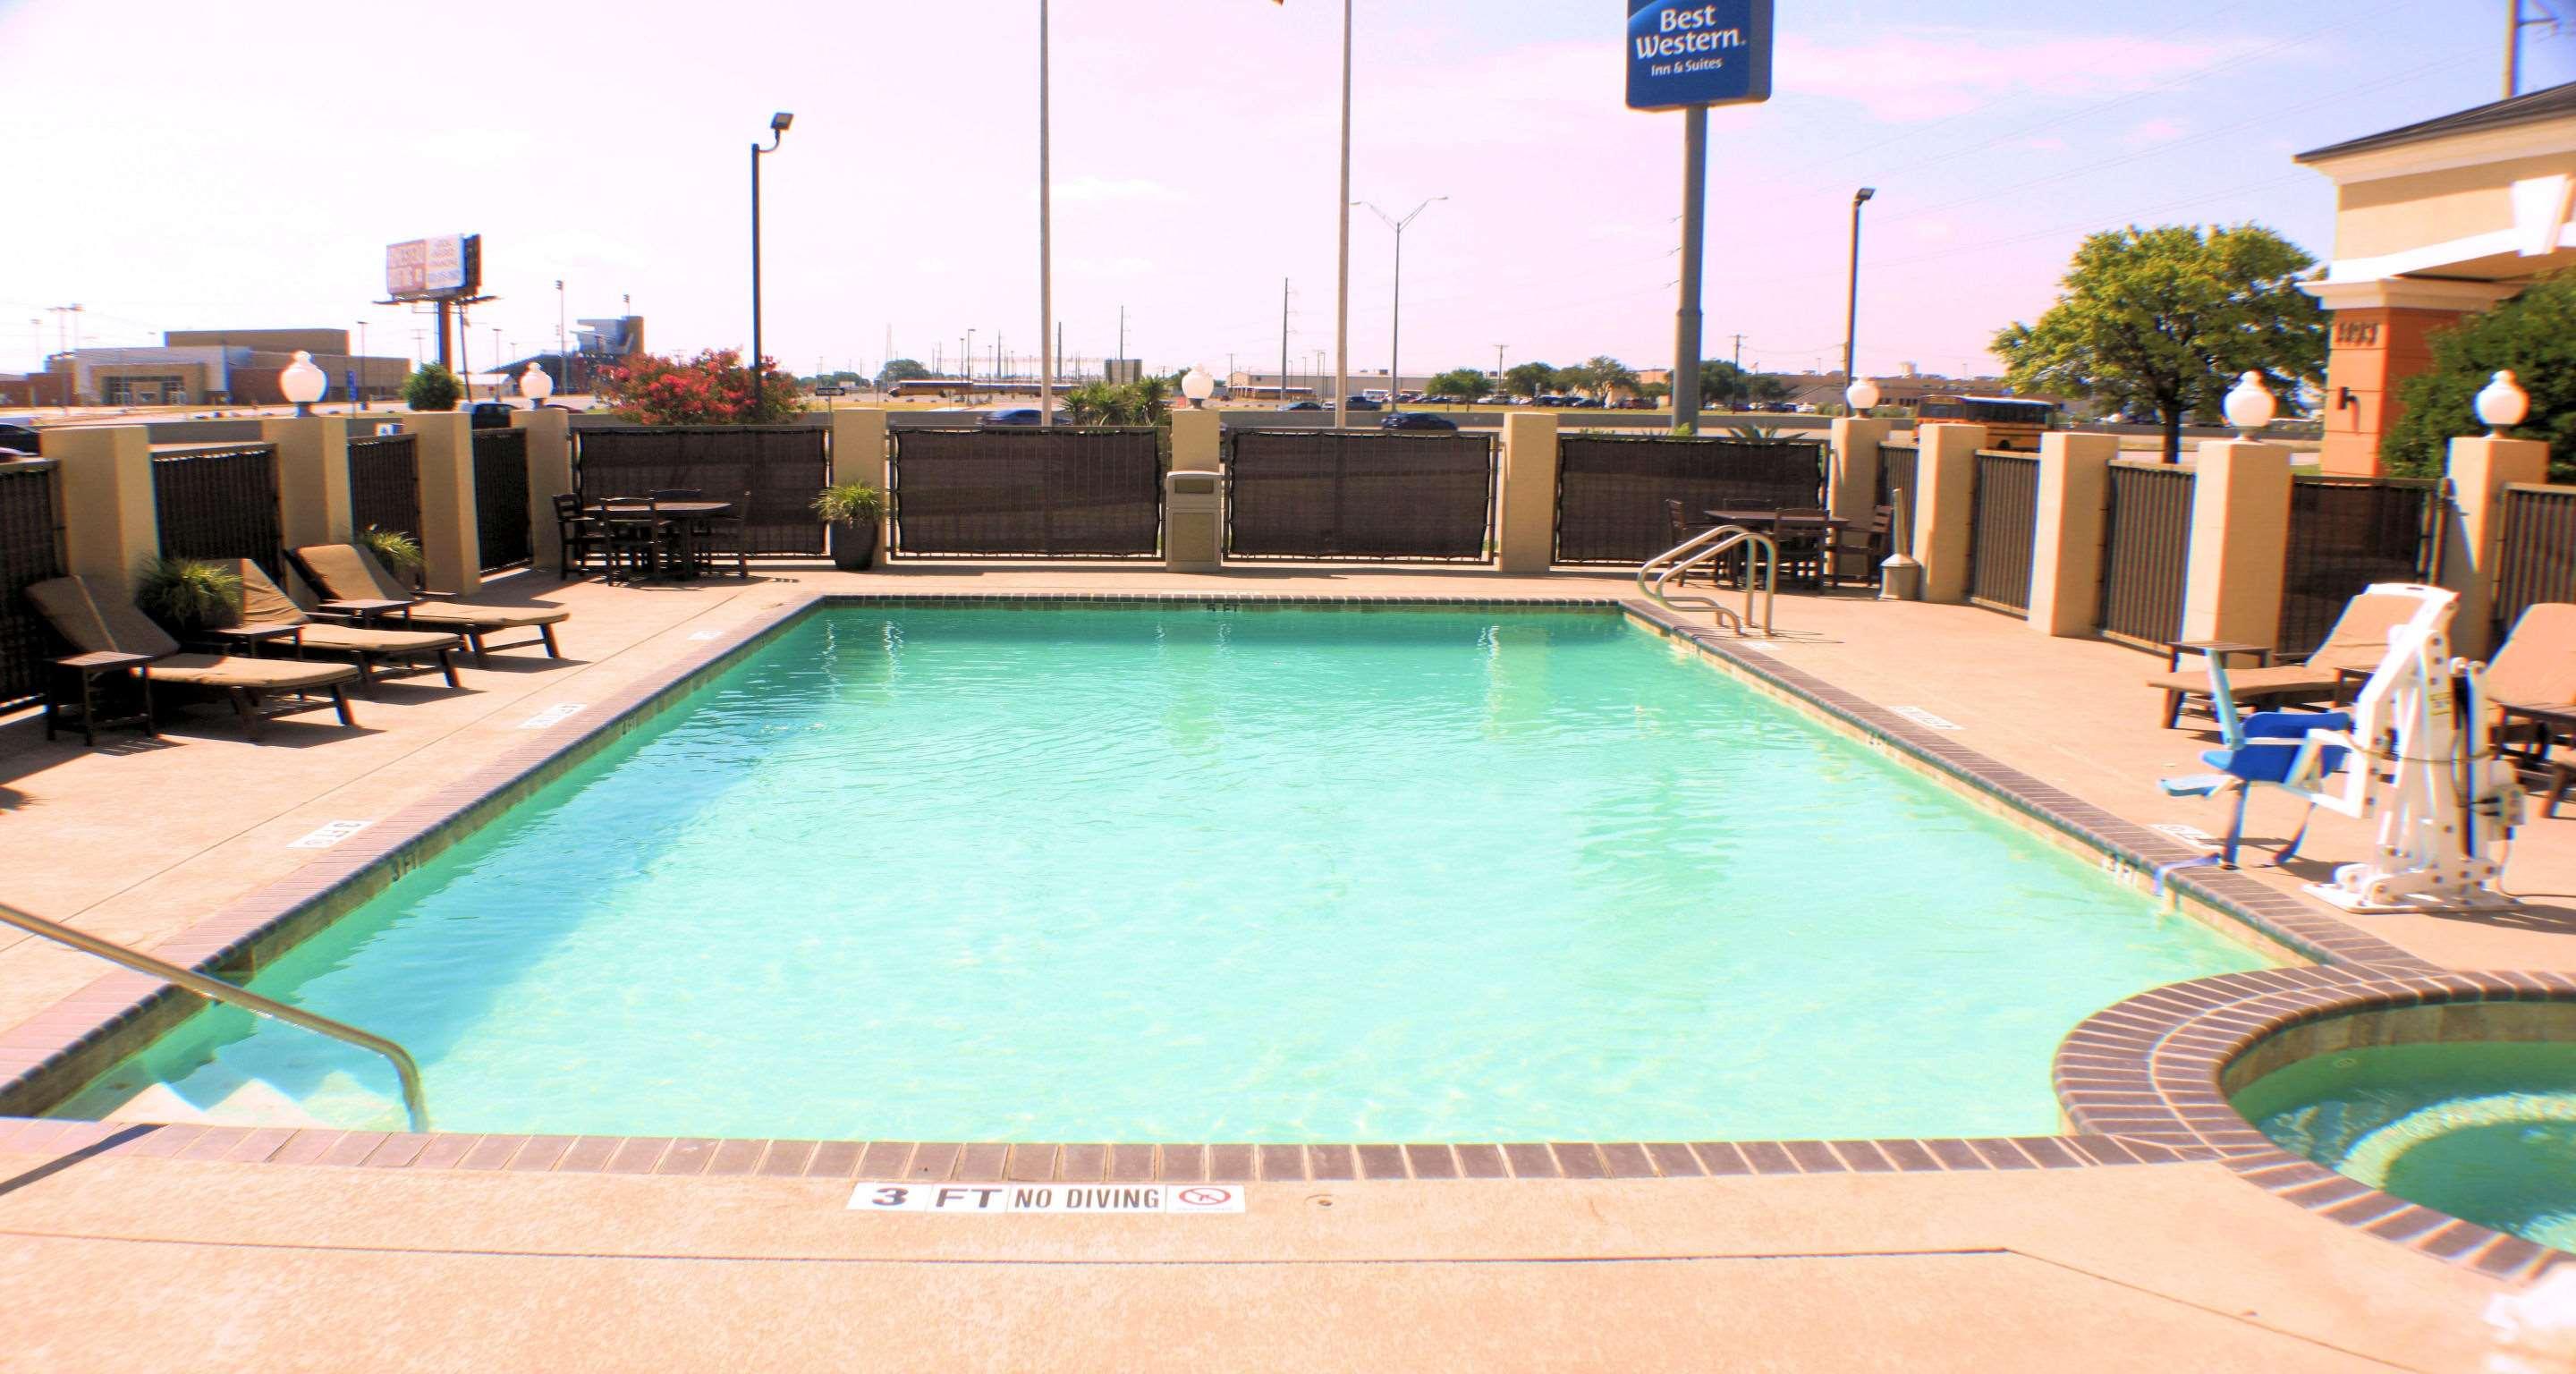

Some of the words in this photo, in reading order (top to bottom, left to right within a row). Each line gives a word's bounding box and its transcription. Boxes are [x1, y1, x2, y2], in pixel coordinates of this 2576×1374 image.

[1660, 4, 1716, 33] Best
[1651, 64, 1671, 77] Inn
[1674, 61, 1683, 73] &
[1685, 57, 1724, 72] Suites
[872, 1187, 910, 1207] 3
[936, 1188, 1004, 1208] FT
[1014, 1188, 1053, 1209] NO
[1066, 1188, 1160, 1209] DIVING
